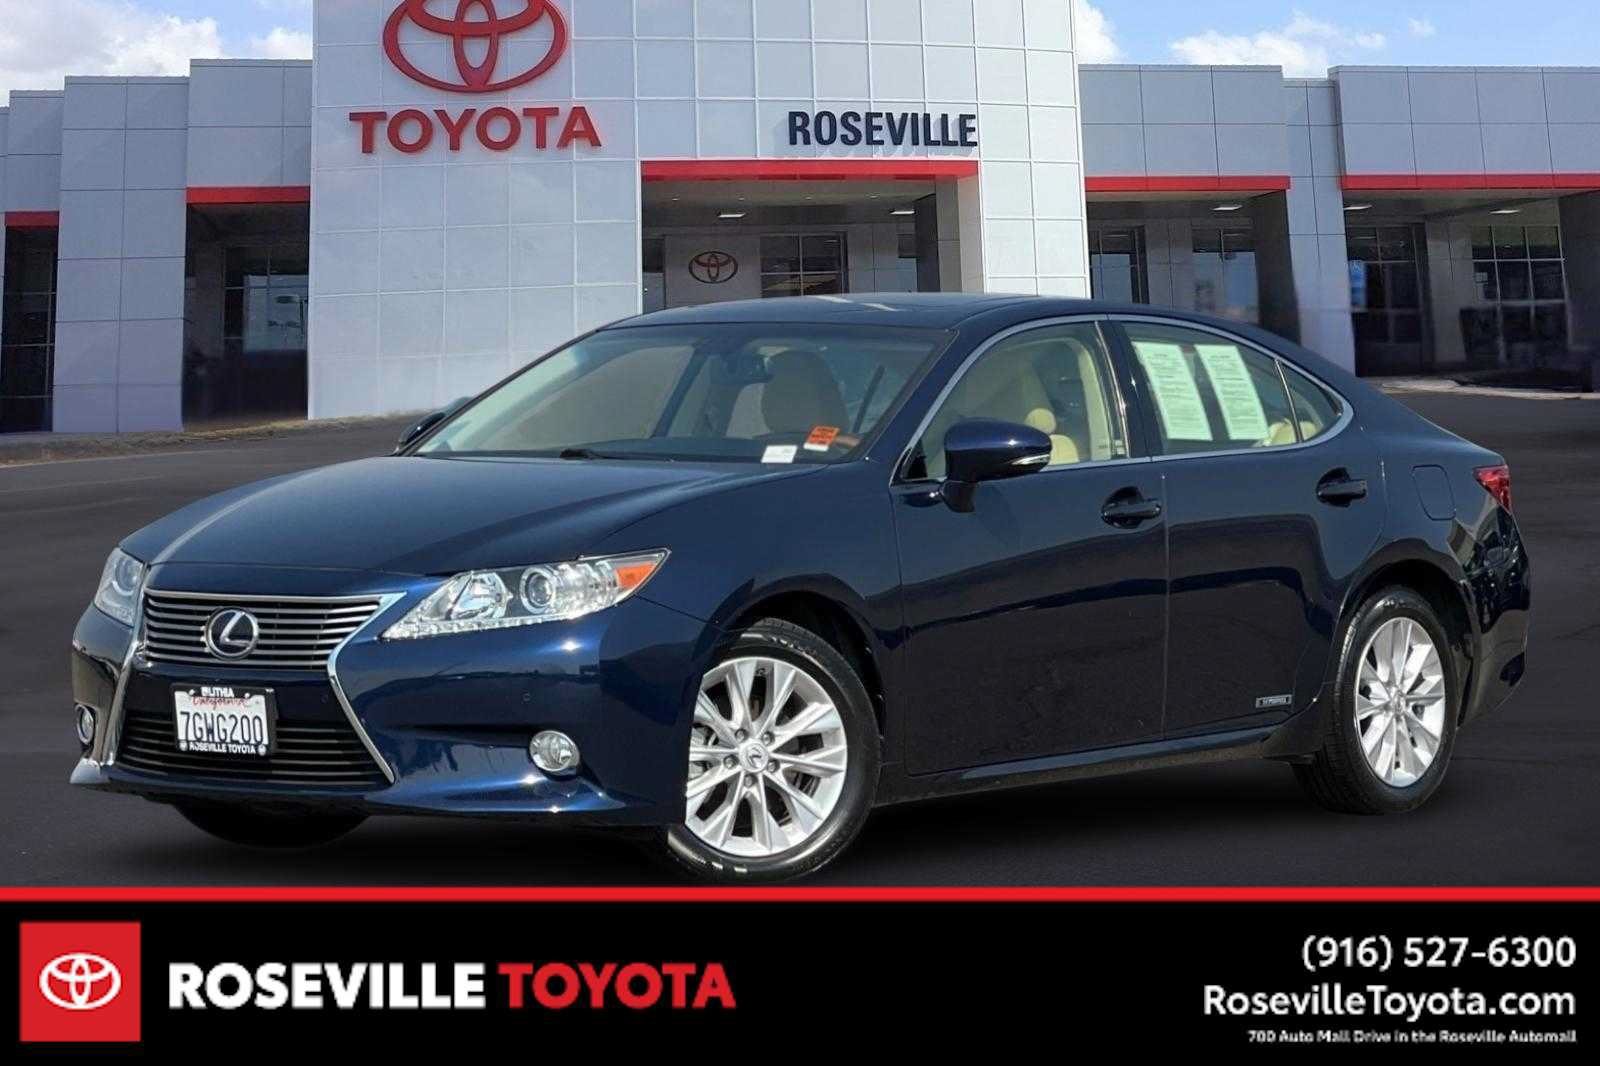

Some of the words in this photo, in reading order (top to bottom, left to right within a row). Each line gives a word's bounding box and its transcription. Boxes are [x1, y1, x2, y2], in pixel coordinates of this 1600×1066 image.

[350, 106, 602, 153] TOYOTA
[789, 111, 978, 147] ROSEVILLE
[179, 711, 265, 745] 7GWG200
[189, 742, 227, 753] ROSEVILLE
[228, 744, 257, 755] TOYOTA
